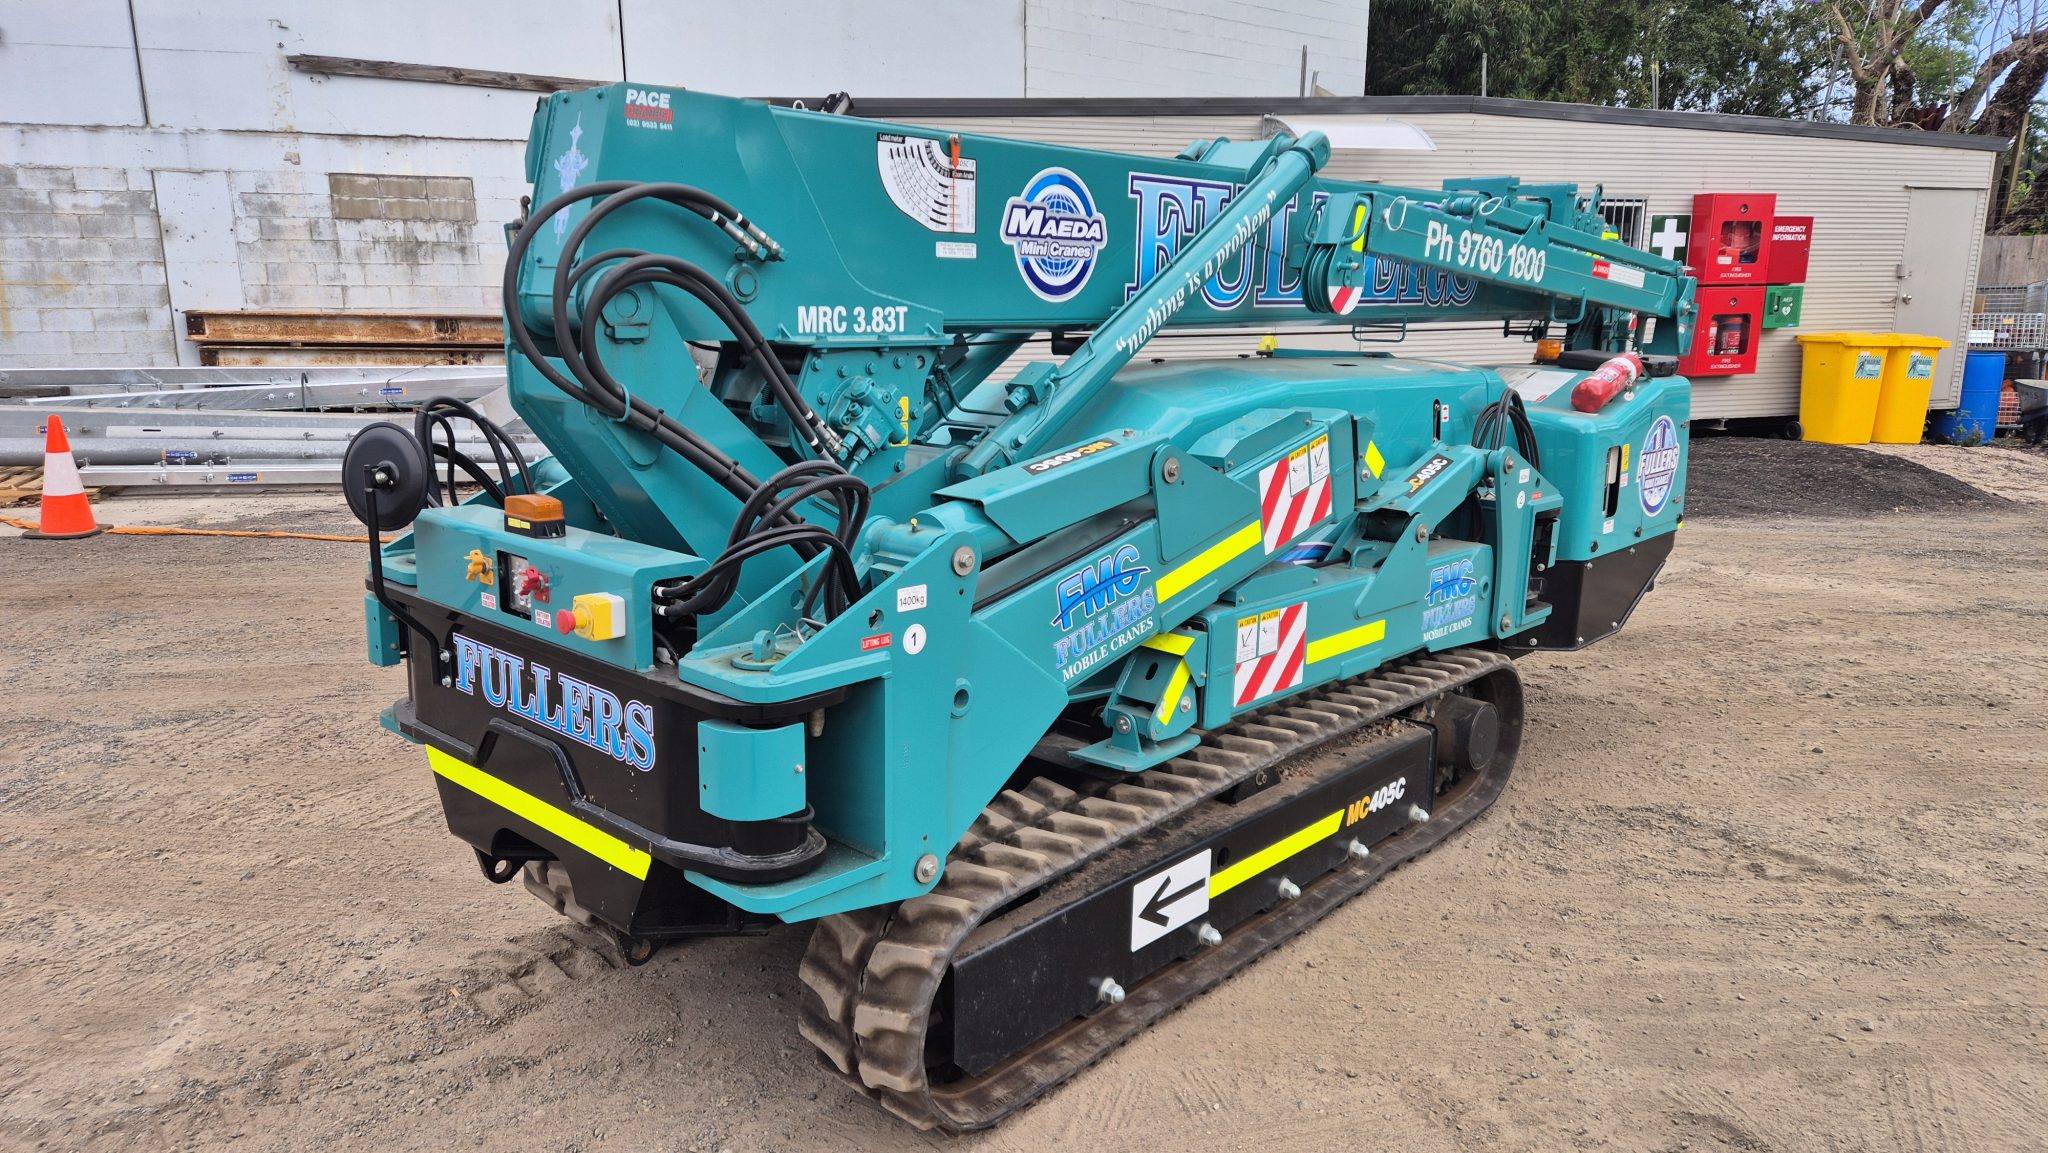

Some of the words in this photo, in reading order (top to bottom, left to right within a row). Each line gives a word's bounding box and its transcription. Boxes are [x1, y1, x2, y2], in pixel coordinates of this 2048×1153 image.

[625, 88, 671, 109] PACE
[1006, 205, 1103, 241] MAEDA
[1771, 233, 1807, 241] INFORMATION
[1774, 225, 1807, 233] EMERGENCY
[1021, 241, 1049, 256] Mini
[1049, 242, 1092, 258] Cranes
[1424, 220, 1454, 263] Ph
[1457, 229, 1504, 274] 9760
[1507, 244, 1547, 284] 1800
[1185, 271, 1201, 296] is
[1204, 260, 1214, 280] a
[797, 305, 849, 334] MRC
[852, 305, 909, 334] 3.83T
[1029, 441, 1113, 471] MC405C
[1639, 447, 1679, 477] FULLERS
[1053, 544, 1146, 631] FMC
[1426, 559, 1475, 606] FMC
[899, 595, 925, 607] 1400kg
[1421, 595, 1476, 631] FULLERS
[911, 632, 917, 647] 1
[1053, 586, 1156, 669] FULLERS
[1423, 626, 1449, 642] MOBILE
[1449, 617, 1472, 633] CRANES
[1062, 644, 1109, 682] MOBILE
[1110, 617, 1154, 651] CRANES
[453, 632, 656, 772] FULLERS
[1346, 776, 1407, 827] MC405C
